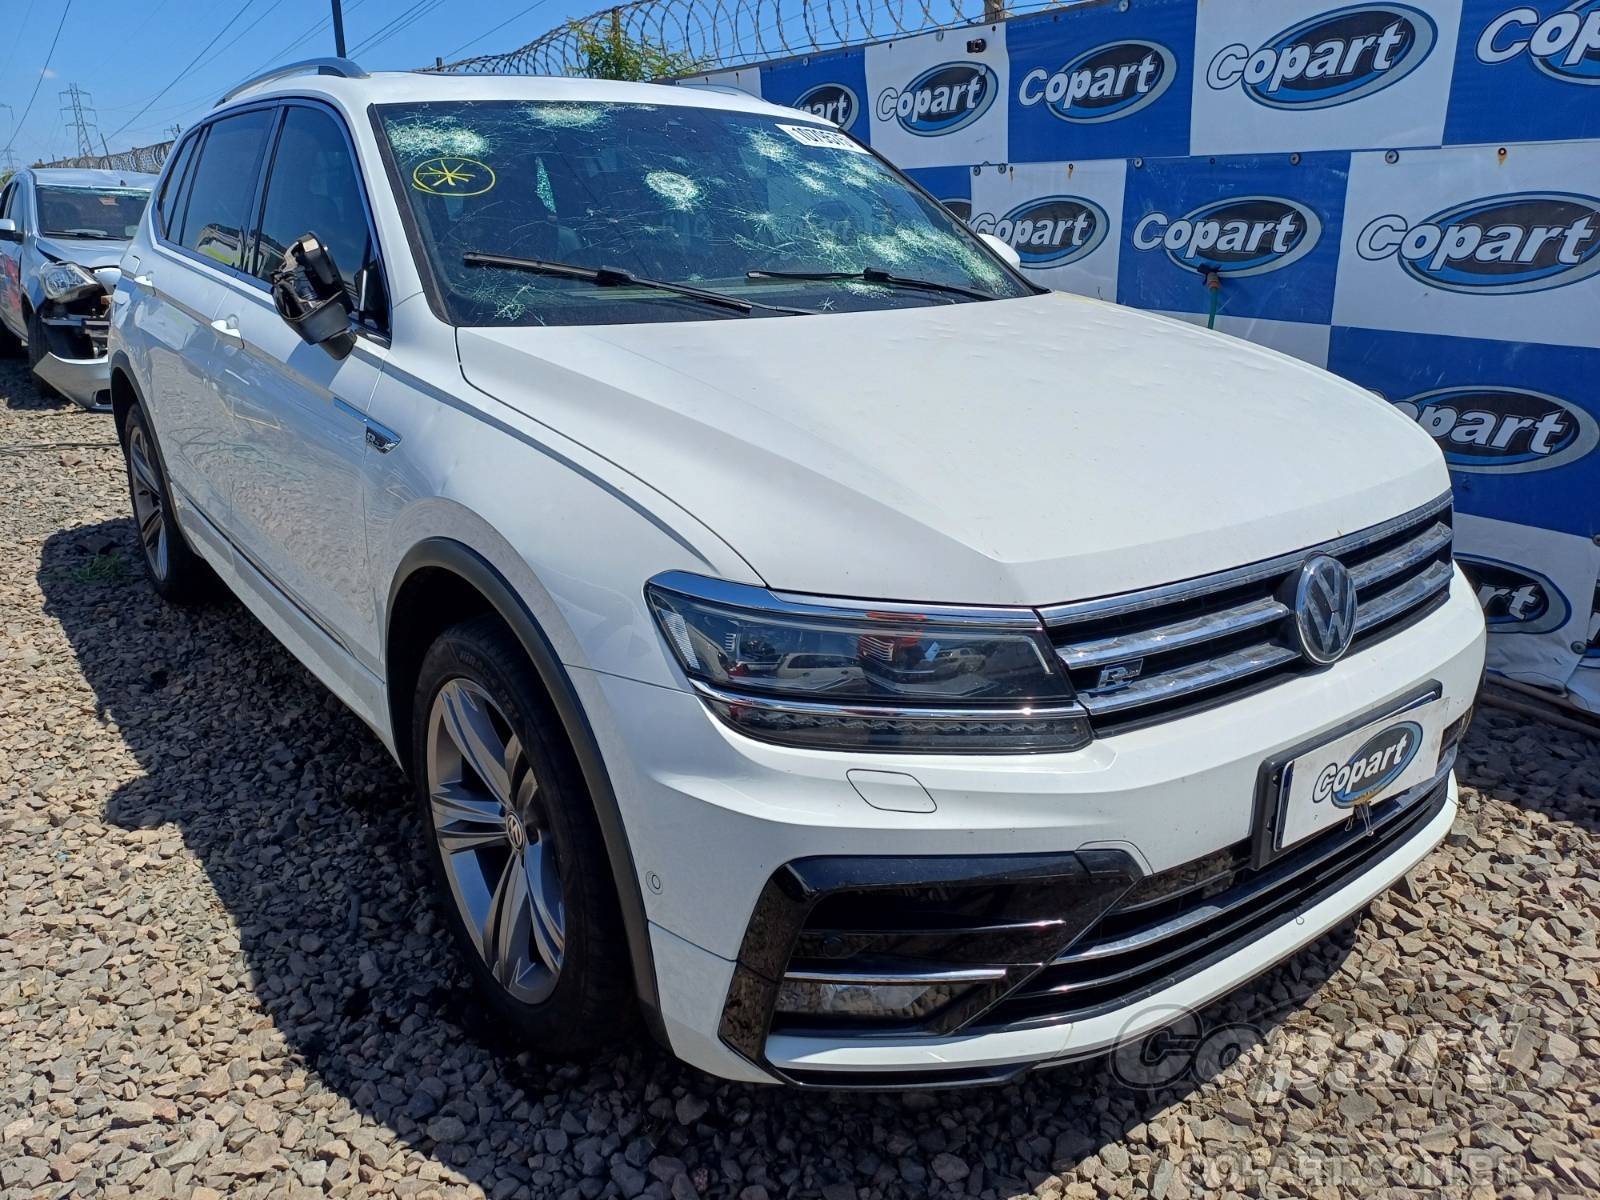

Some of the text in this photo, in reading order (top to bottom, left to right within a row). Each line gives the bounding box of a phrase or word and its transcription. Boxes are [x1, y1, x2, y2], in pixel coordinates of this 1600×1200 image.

[1206, 19, 1404, 94] Copart
[1475, 6, 1600, 67] Cop
[876, 75, 982, 122] Copart
[1018, 52, 1157, 108] Copart
[799, 93, 848, 124] art
[1132, 211, 1302, 259] Copart
[1356, 212, 1600, 272] Copart
[1391, 400, 1568, 455] part
[1312, 732, 1409, 804] Copart
